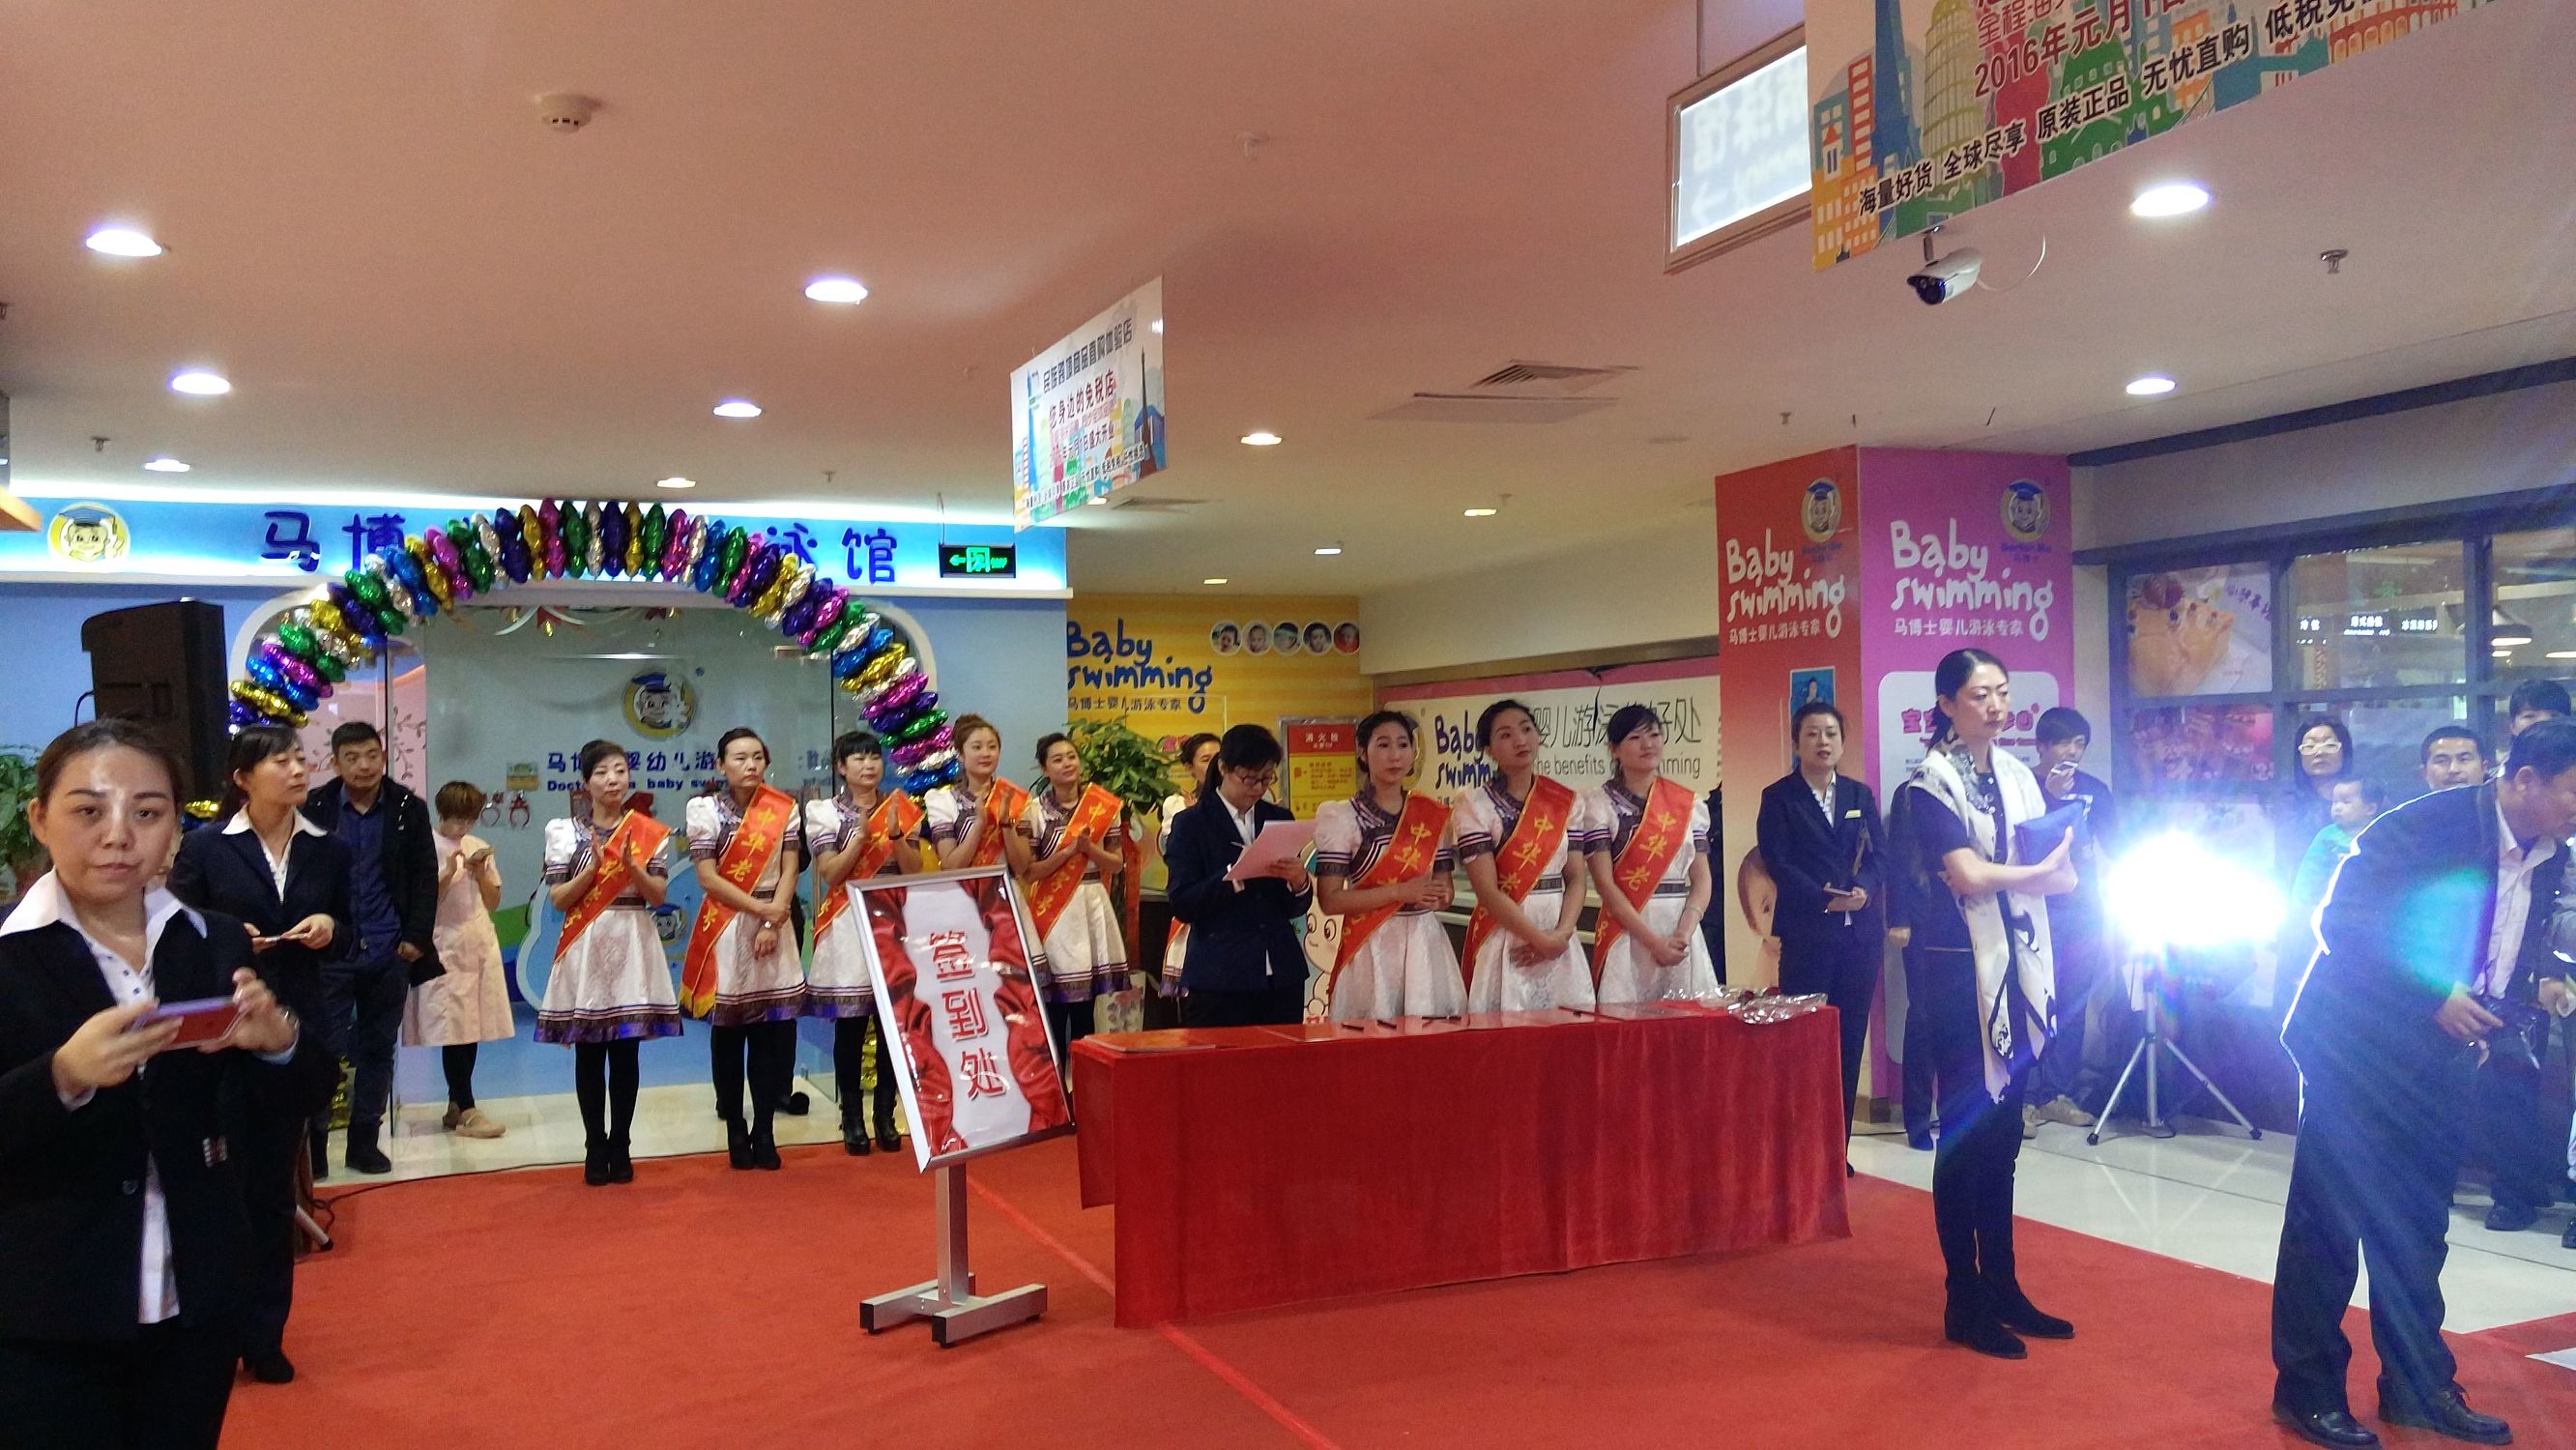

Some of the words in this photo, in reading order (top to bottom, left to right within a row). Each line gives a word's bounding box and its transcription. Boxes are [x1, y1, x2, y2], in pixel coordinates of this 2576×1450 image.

[1859, 160, 1933, 216] 海量好货
[1943, 123, 2026, 180] 全球尽享
[2037, 76, 2129, 138] 原装正品
[2143, 23, 2249, 96] 无忧直购
[2265, 0, 2368, 44] 低税免
[1725, 528, 1795, 588] Baby
[1891, 517, 1988, 582] Baby
[1726, 567, 1845, 639] swimming
[1891, 567, 2054, 642] swimming
[1066, 619, 1152, 666] Baby
[1067, 655, 1213, 714] swimming
[647, 778, 683, 791] baby
[1434, 762, 1491, 791] swimm
[1554, 754, 1606, 775] benefits
